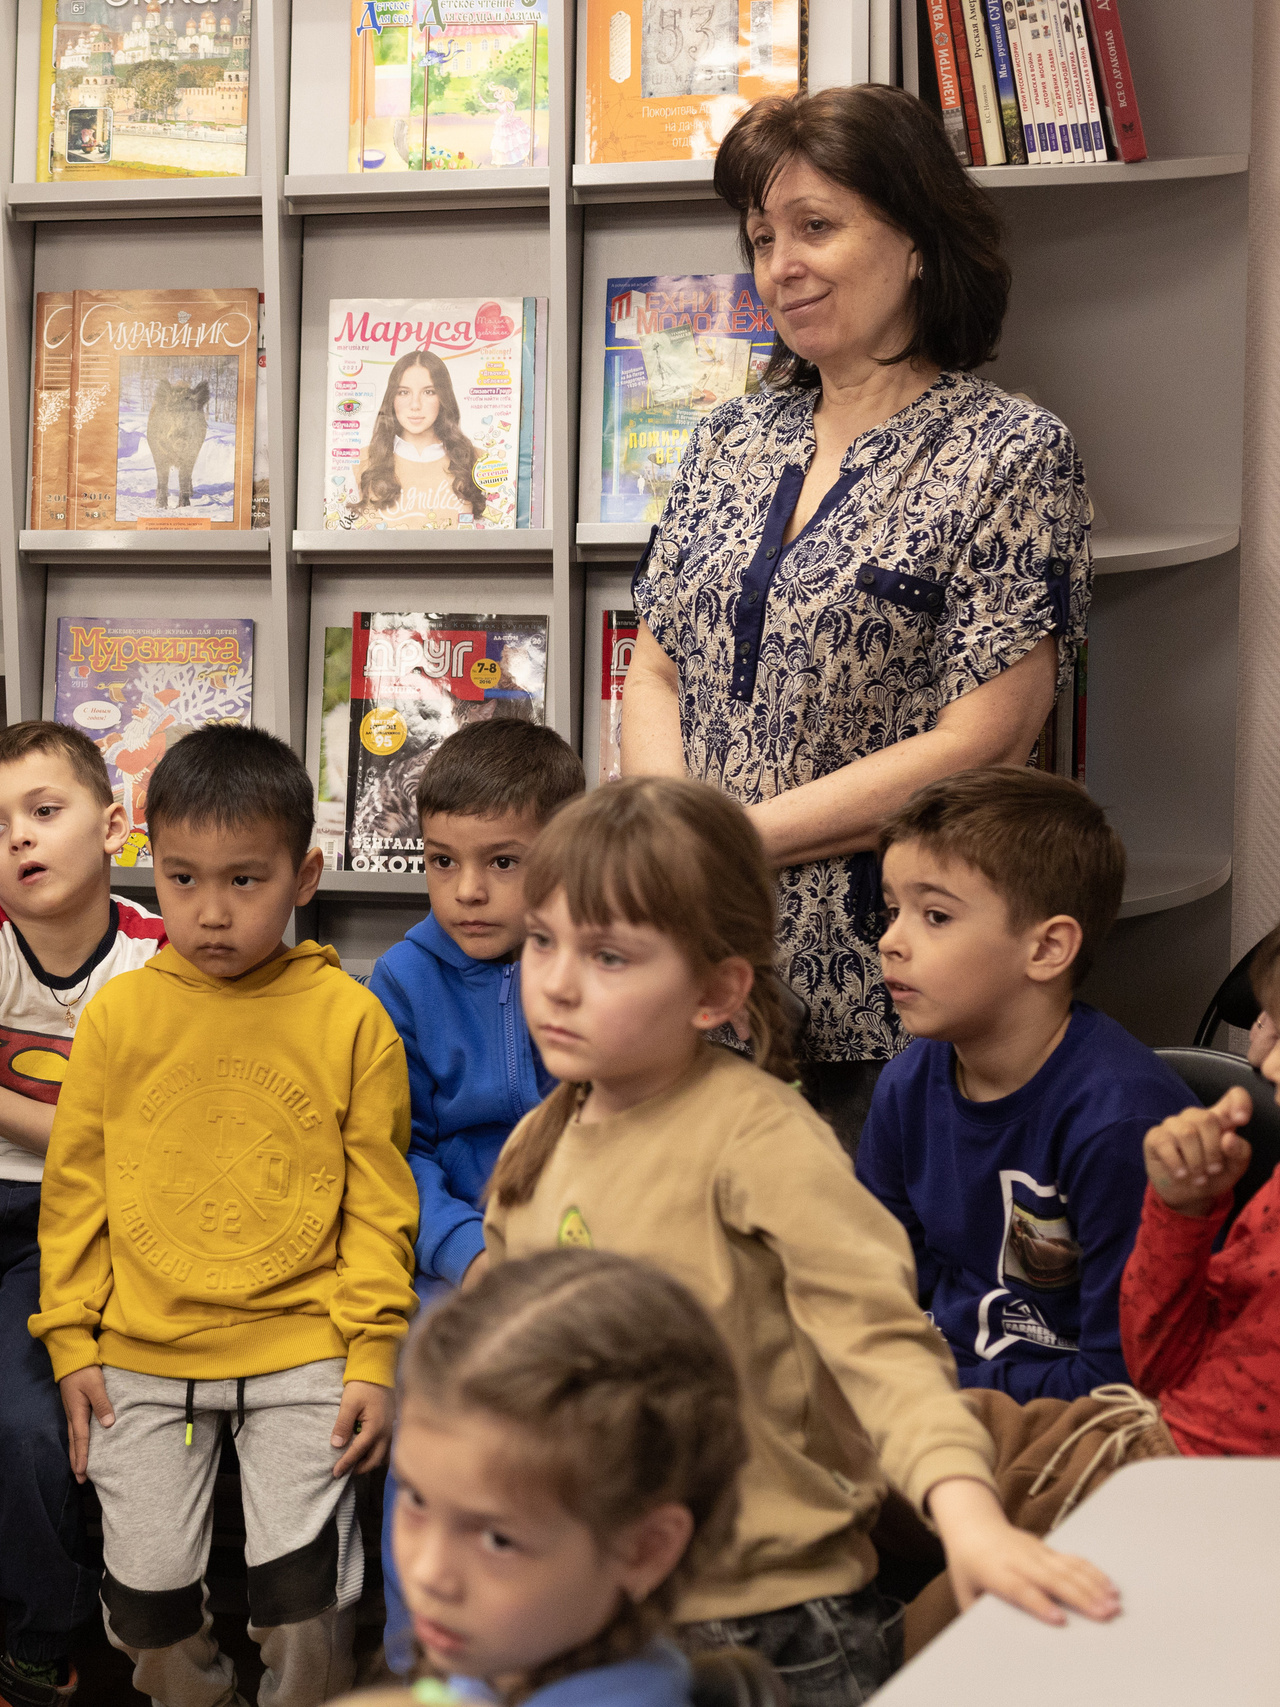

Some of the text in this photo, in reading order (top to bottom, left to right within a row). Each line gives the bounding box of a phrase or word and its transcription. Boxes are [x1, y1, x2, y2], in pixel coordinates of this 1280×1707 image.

[72, 4, 84, 13] 6+
[503, 11, 542, 25] разума
[973, 22, 985, 59] Русская
[994, 23, 1008, 79] Мы русские!
[1104, 29, 1123, 80] ДРАКОНАХ
[937, 48, 956, 106] ИЗНУТРИ
[1012, 41, 1029, 112] ГЕРОИ РУССКОЙ ИСТОРИИ
[1031, 73, 1041, 105] КРЫМСКАЯ
[1036, 53, 1050, 108] ИСТОРИЯ МОСКВЫ
[1047, 48, 1064, 117] БОГИ ДРЕВНИХ СЛАВЯН
[1060, 60, 1074, 109] КНЯЗЬ-ЧАРОДЕЙ
[1069, 50, 1083, 106] РУССКАЯ АМЕРИКА
[1080, 46, 1096, 113] ГРАЖДАНСКАЯ ВОЙНА
[642, 105, 698, 119] Покоритель
[1117, 90, 1128, 108] ВСЕ
[664, 123, 676, 133] на
[334, 311, 473, 356] Маруся
[336, 344, 370, 352] marusia.ru
[69, 626, 243, 673] Мурзилка
[107, 628, 238, 636] ЕЖЕМЕСЯЧНЫЙ ЖУРНАЛ ДЛЯ ДЕТЕЙ
[229, 666, 239, 675] 6+
[363, 639, 473, 678] ДРУГ
[477, 662, 498, 674] 7-8
[89, 707, 112, 715] Новым
[375, 735, 393, 748] 95
[138, 1055, 322, 1132] DENIM ORIGINALS
[198, 1199, 242, 1234] 92
[120, 1194, 324, 1290] AUTHENTIC APPAREL
